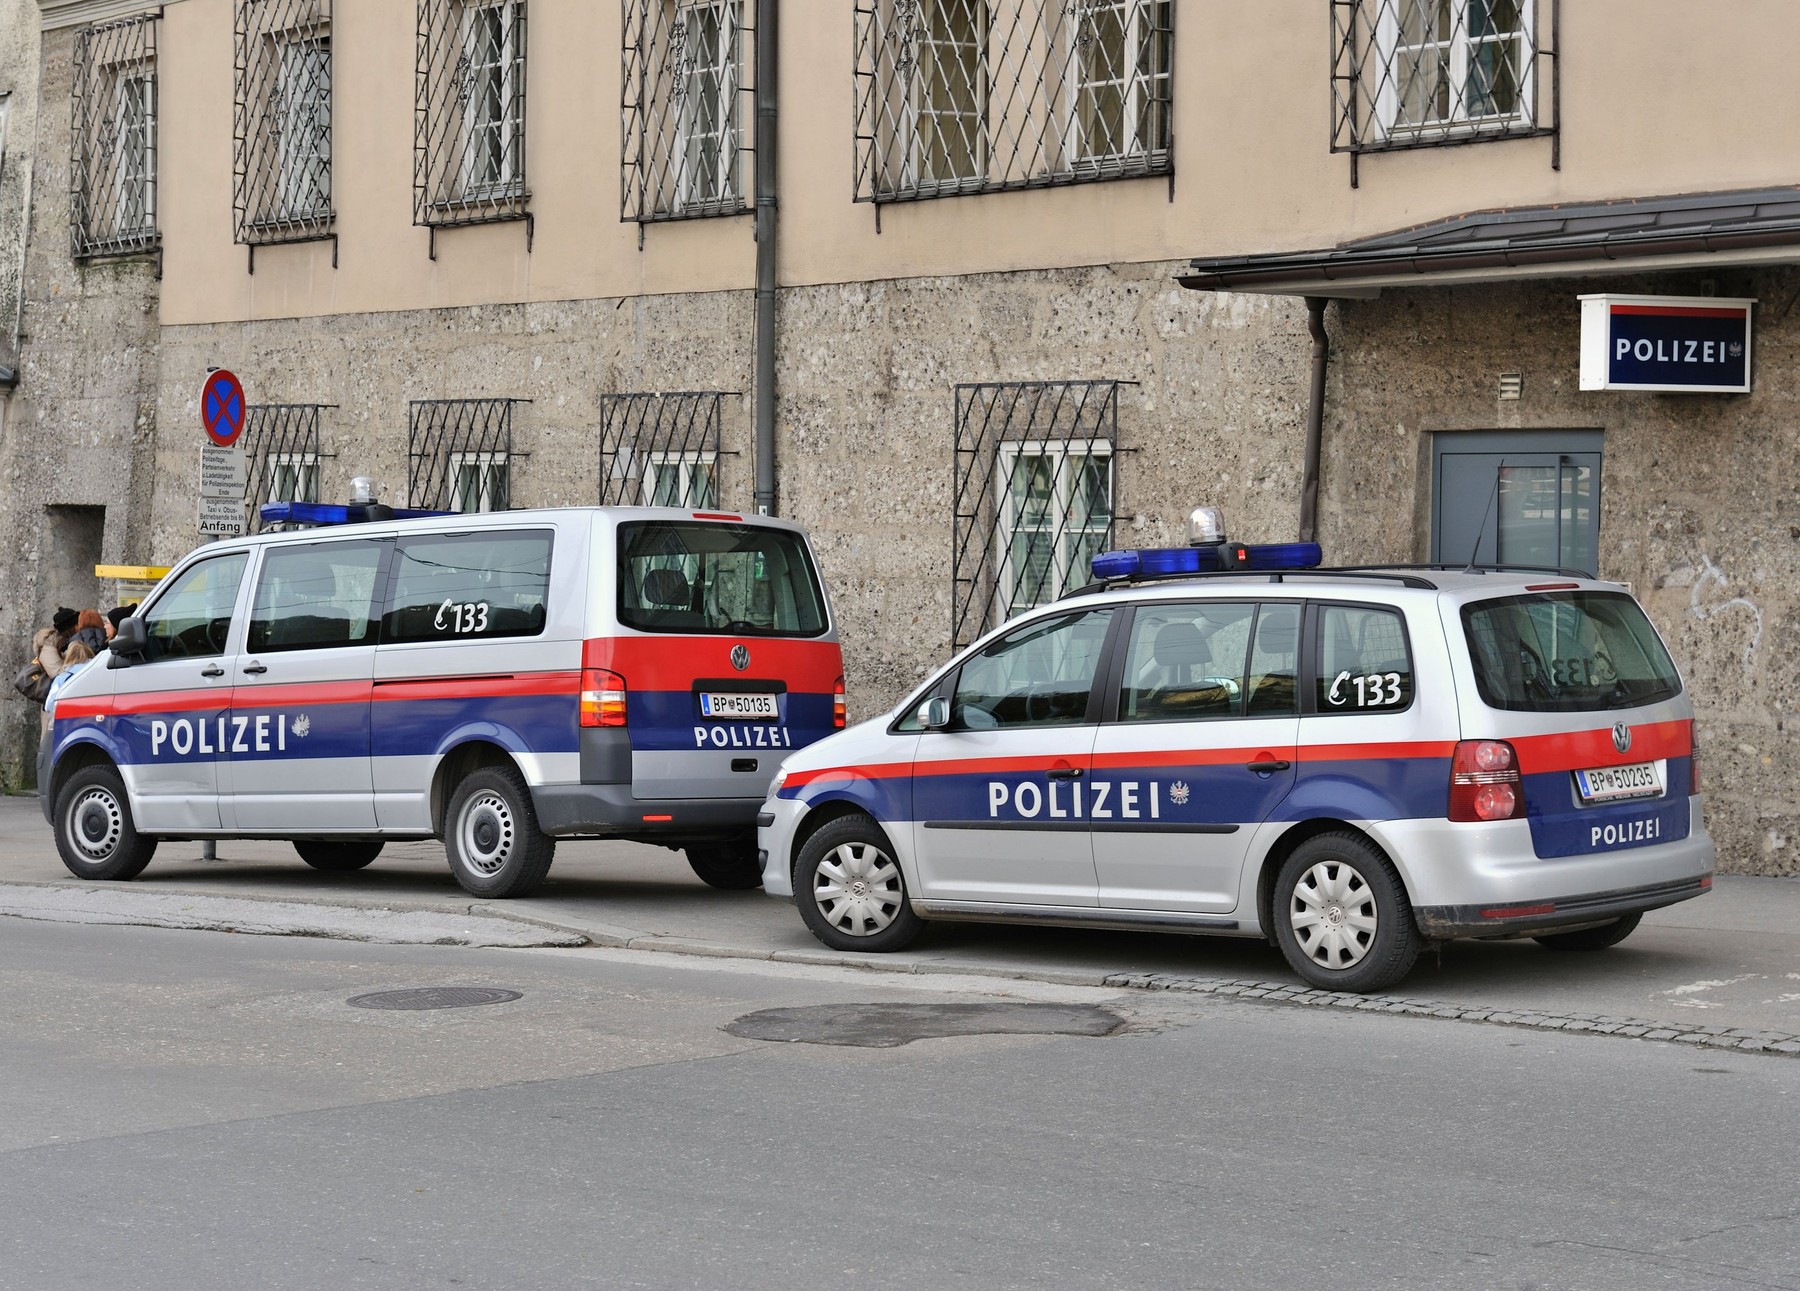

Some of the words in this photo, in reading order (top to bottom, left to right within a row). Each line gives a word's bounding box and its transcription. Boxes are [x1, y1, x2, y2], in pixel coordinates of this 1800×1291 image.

[1616, 338, 1726, 363] POLIZEI
[200, 512, 229, 521] Betriebsende
[207, 505, 217, 513] Taxi
[223, 506, 238, 514] Obus-
[200, 520, 241, 534] Anfang
[453, 602, 489, 633] 133
[1352, 672, 1402, 707] 133
[713, 696, 727, 712] BP
[736, 697, 771, 713] 50135
[151, 714, 286, 756] POLIZEI
[693, 725, 791, 747] POLIZEI
[1589, 772, 1605, 792] BP
[1612, 766, 1654, 789] 50235
[988, 781, 1160, 818] POLIZEI
[1591, 816, 1660, 847] POLIZEI
